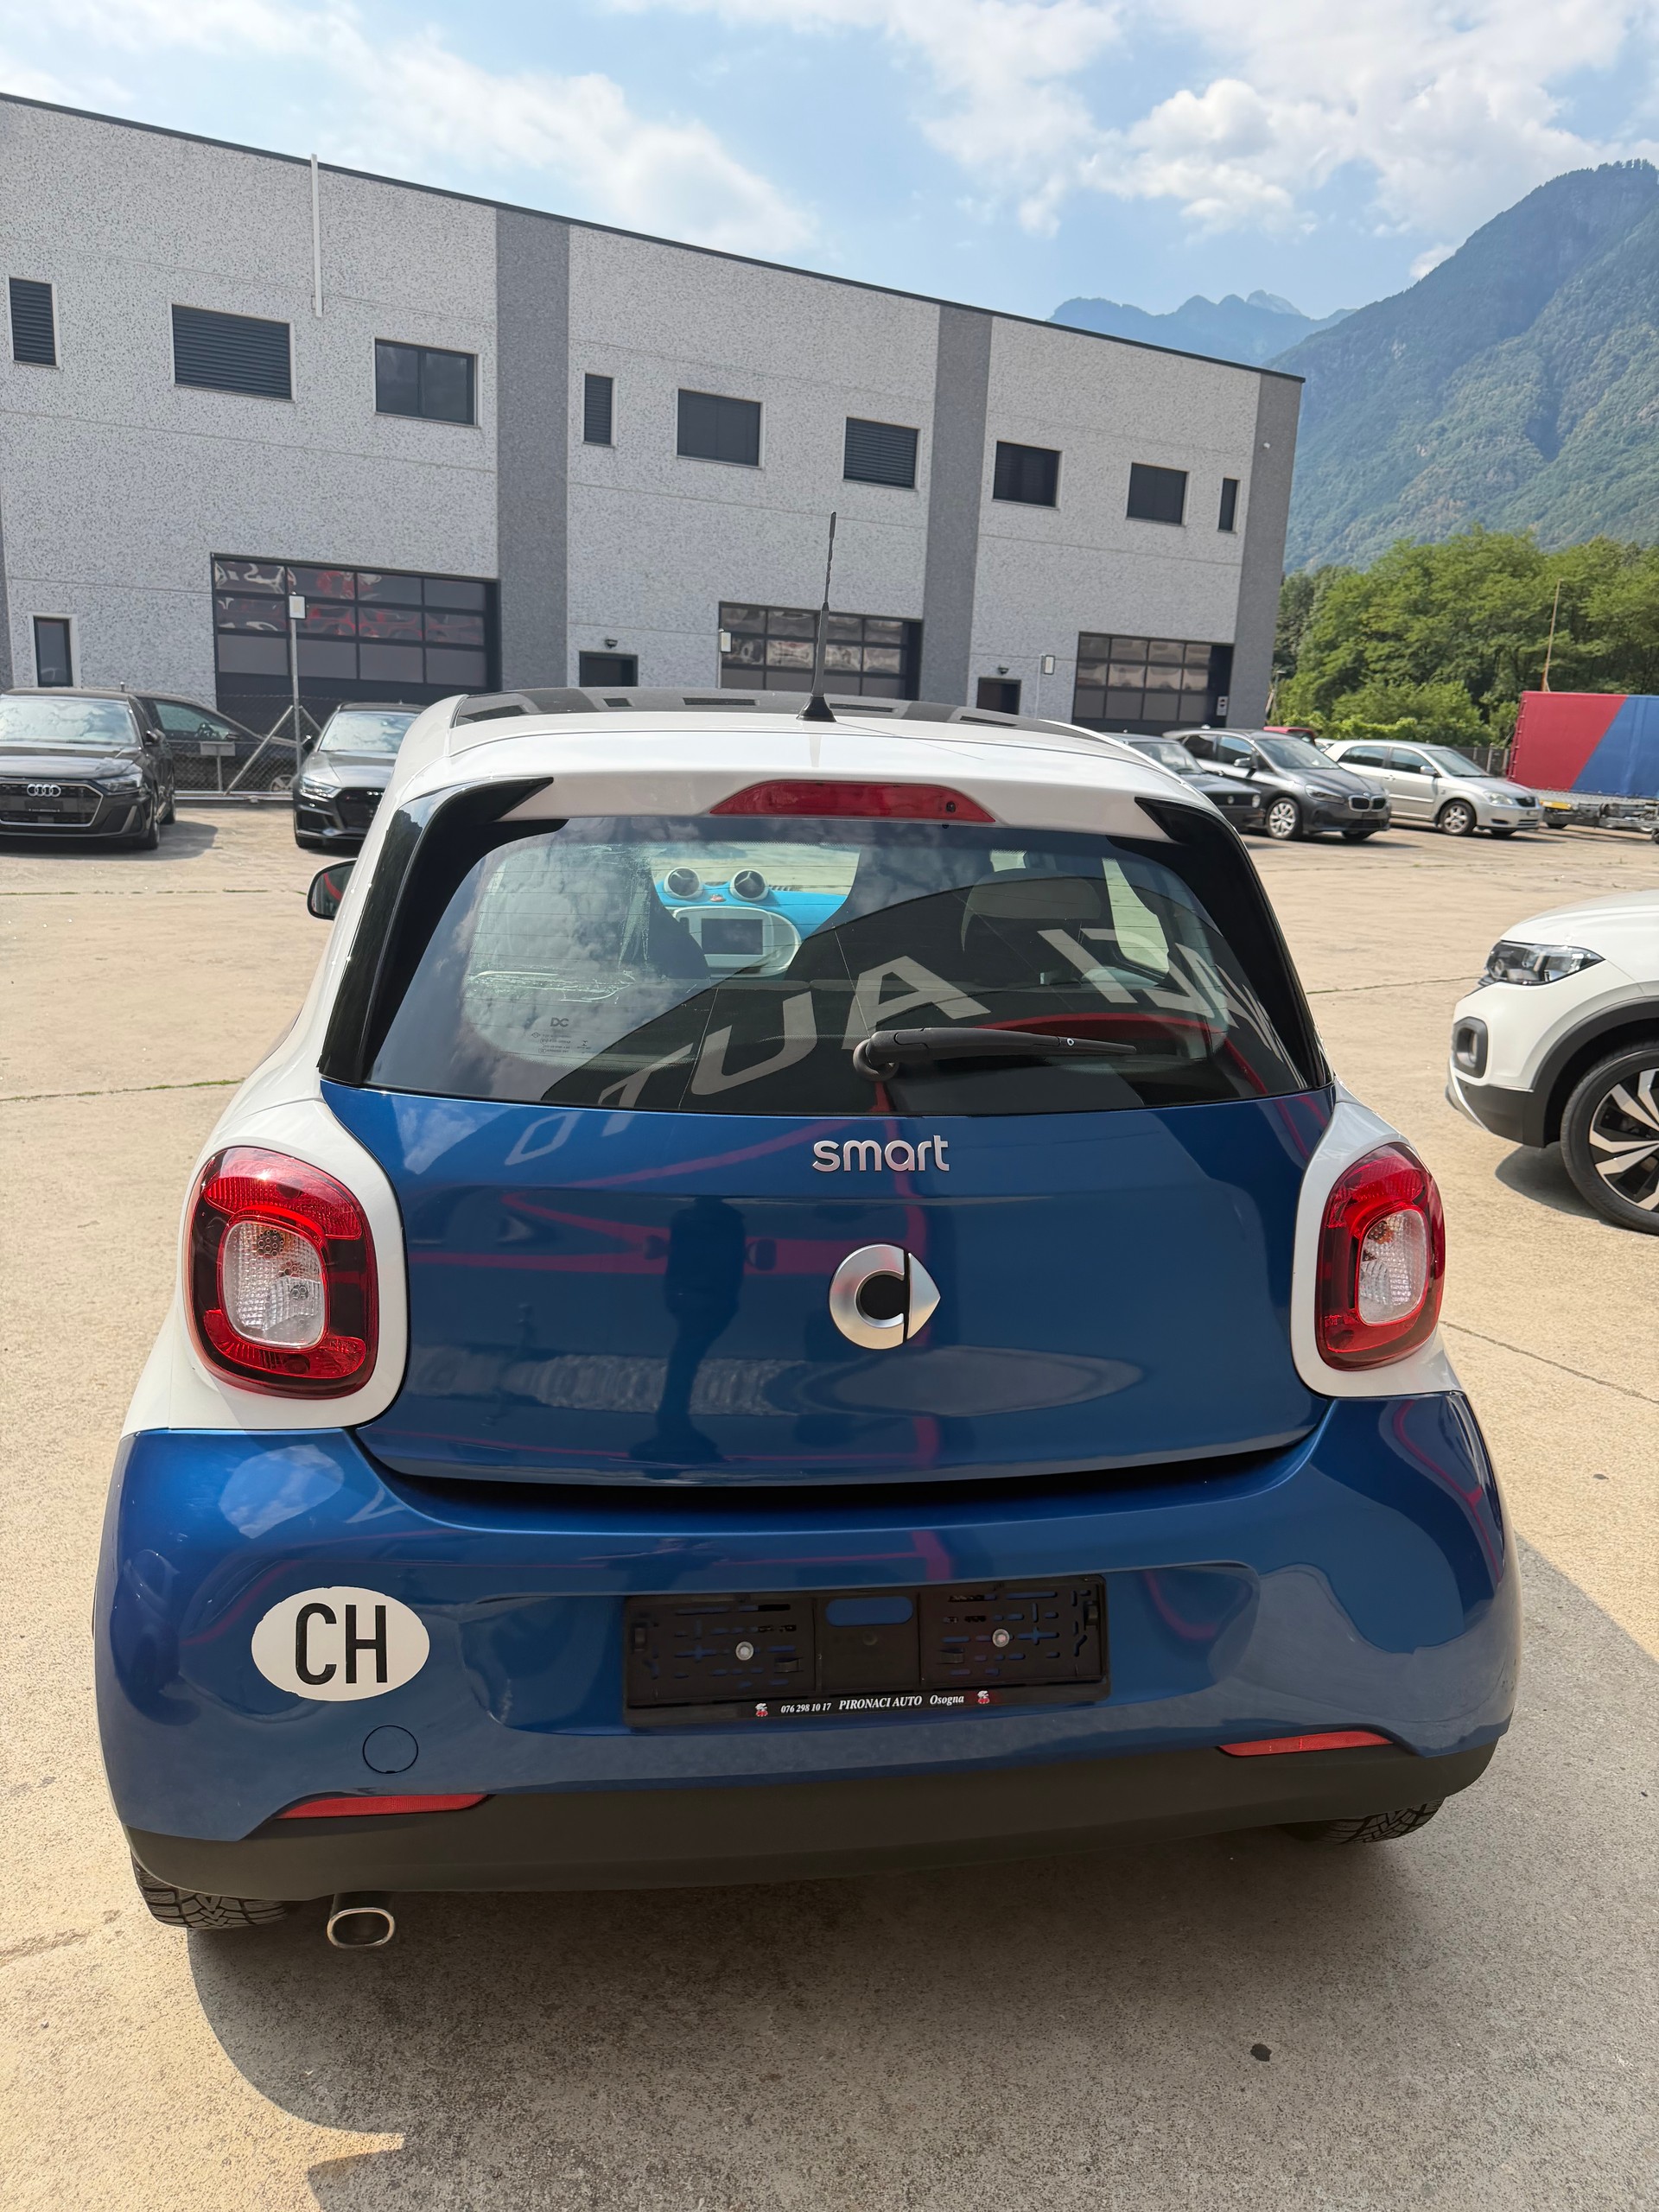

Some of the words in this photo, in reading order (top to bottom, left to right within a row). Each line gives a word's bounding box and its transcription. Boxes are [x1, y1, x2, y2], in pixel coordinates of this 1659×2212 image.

[812, 1135, 950, 1172] smart
[295, 1602, 388, 1686] CH
[780, 1704, 795, 1713] 076
[796, 1703, 810, 1713] 298
[811, 1703, 821, 1712] 10
[822, 1702, 832, 1711] 17
[838, 1697, 891, 1710] PIRONACI
[892, 1695, 923, 1707] AUTO
[929, 1694, 964, 1707] Osogna
